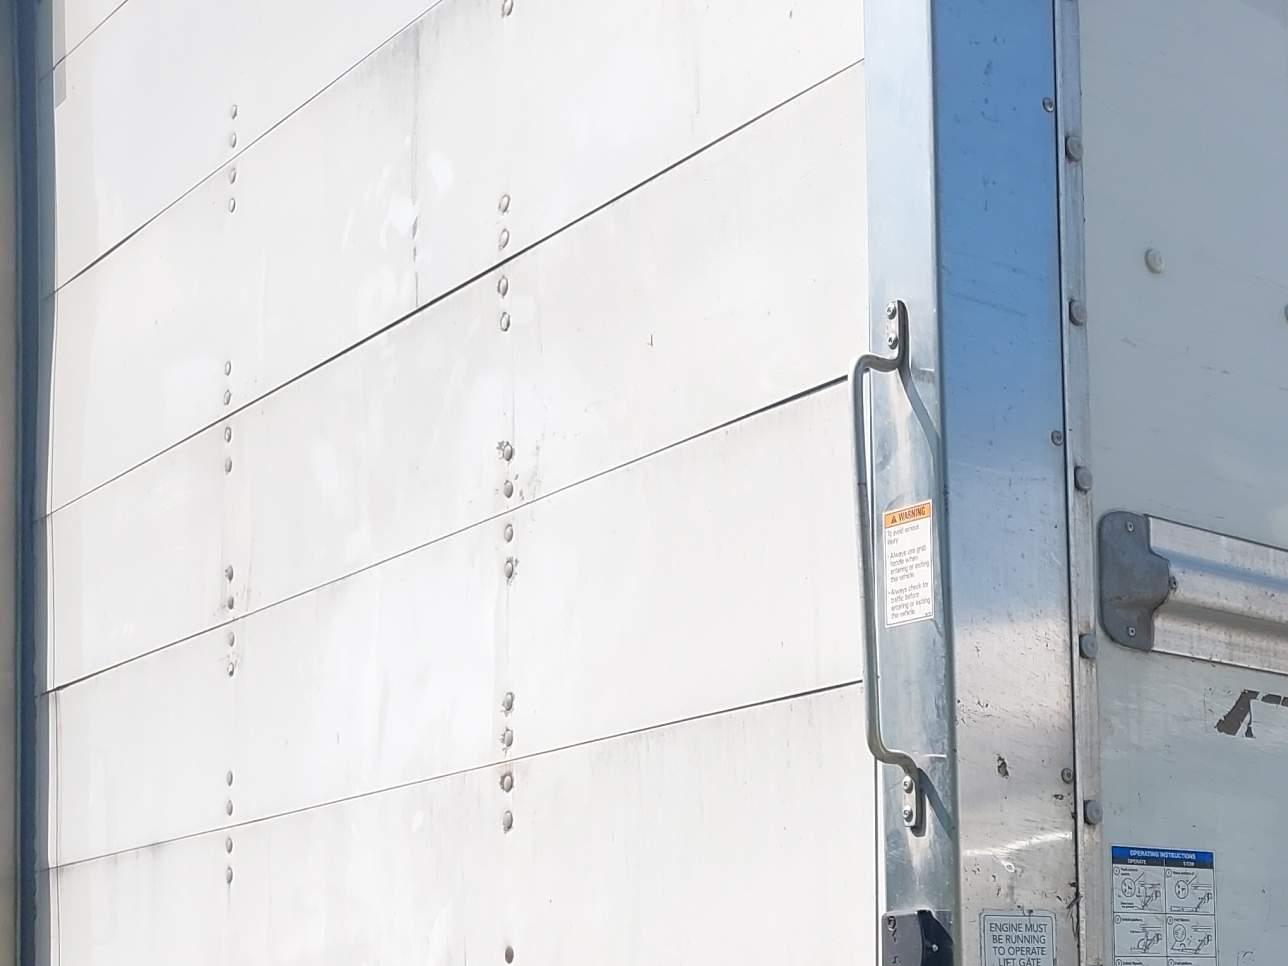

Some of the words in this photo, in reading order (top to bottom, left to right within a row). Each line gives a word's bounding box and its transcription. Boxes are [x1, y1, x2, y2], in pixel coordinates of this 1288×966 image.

[898, 506, 926, 521] WARNING
[890, 550, 906, 559] Always
[890, 586, 908, 596] Always
[1129, 849, 1160, 858] OPERATING
[1160, 851, 1196, 860] INSTRUCTIONS
[989, 922, 1022, 933] ENGINE
[1024, 923, 1048, 933] MUST
[992, 934, 1003, 944] BE
[1005, 934, 1046, 945] RUNNING
[992, 946, 1006, 956] TO
[1007, 946, 1047, 956] OPERATE
[1018, 957, 1041, 966] GATE
